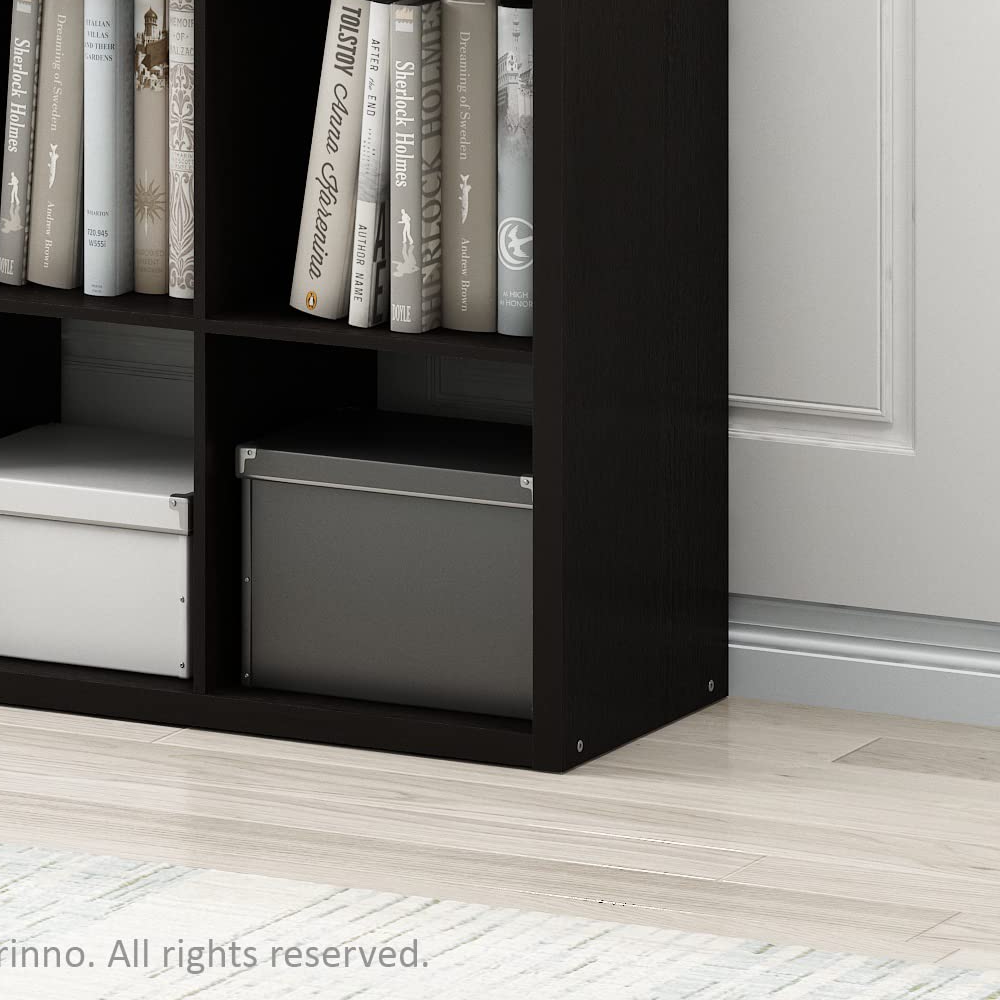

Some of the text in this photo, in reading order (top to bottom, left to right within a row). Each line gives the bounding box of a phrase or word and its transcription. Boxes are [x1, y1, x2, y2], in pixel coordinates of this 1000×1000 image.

[52, 14, 67, 70] Dreaming
[95, 42, 116, 51] THEIR
[369, 38, 381, 72] AFTER
[8, 37, 31, 153] Sherlock Holmes
[53, 72, 63, 86] of
[50, 86, 63, 131] Sweden
[366, 94, 377, 117] END
[395, 60, 415, 188] Sherlock Holmes
[309, 5, 362, 281] TOLSTOY Anna Karenina
[457, 31, 471, 312] Dreaming of Sweden Andrew Brown
[43, 239, 53, 268] Brown
[353, 223, 368, 303] AUTHOR NAME
[391, 303, 412, 322] DOYLE
